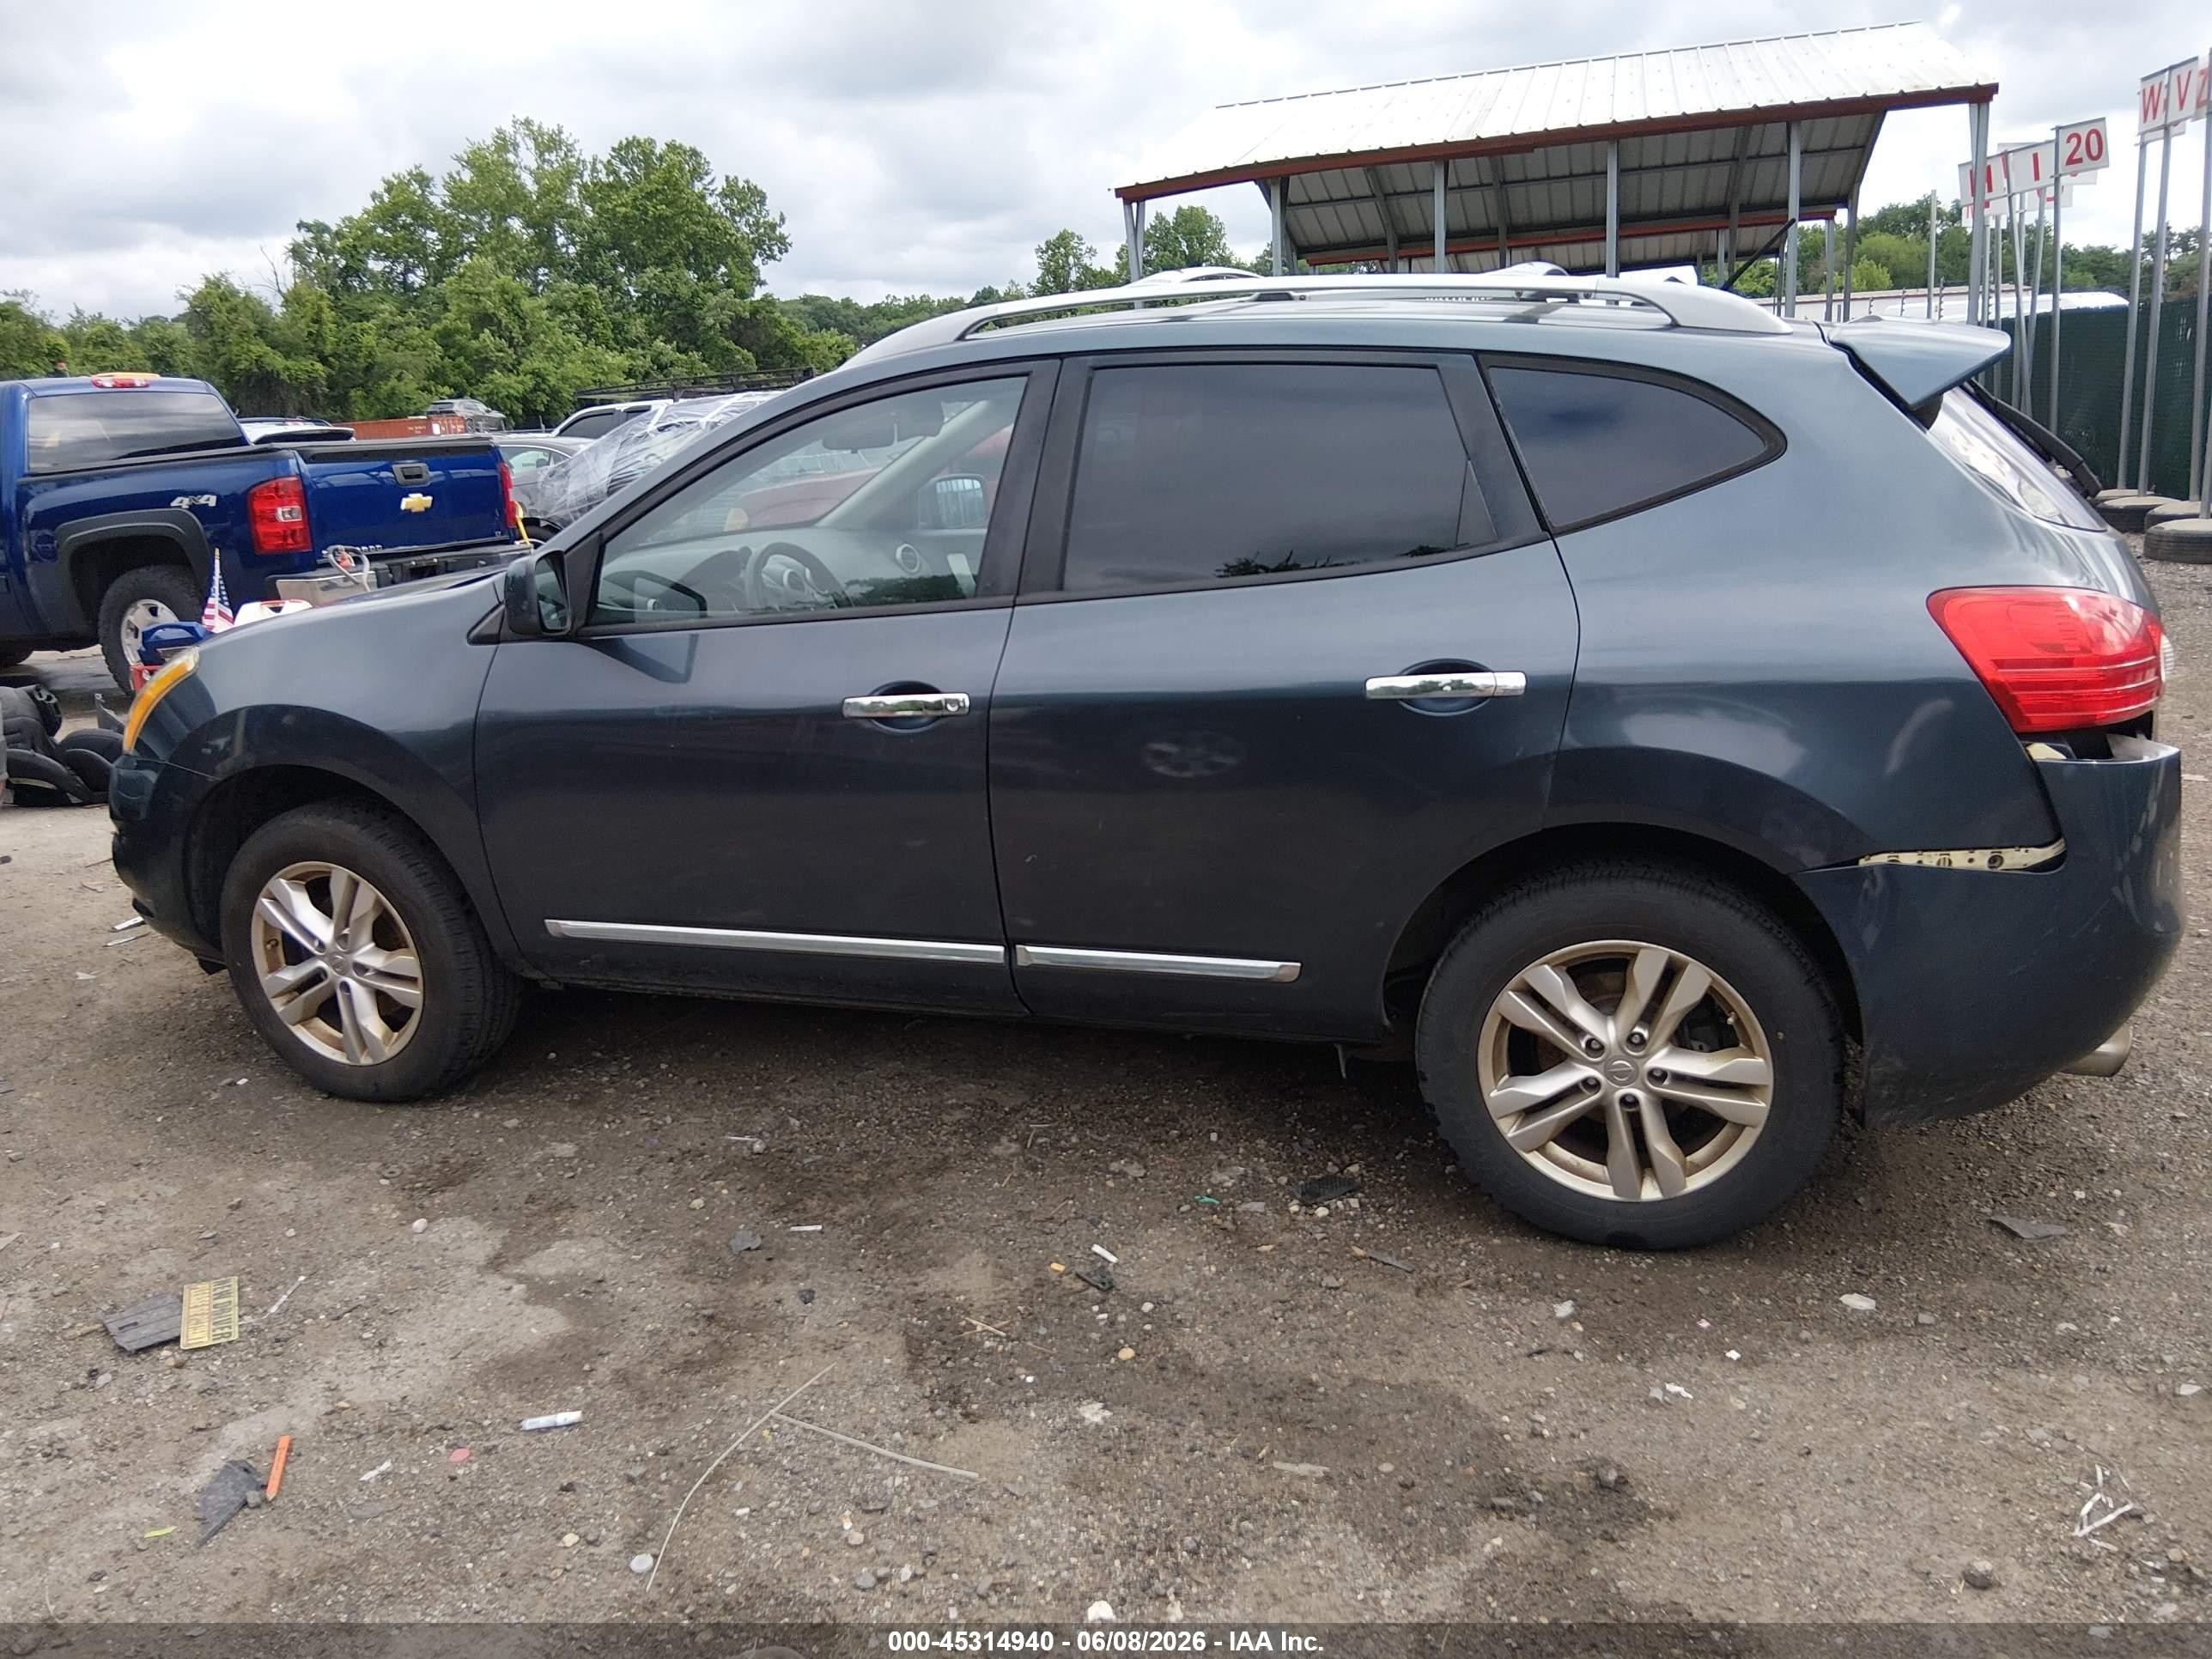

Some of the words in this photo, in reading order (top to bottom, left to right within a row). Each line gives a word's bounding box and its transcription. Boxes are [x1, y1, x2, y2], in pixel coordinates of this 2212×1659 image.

[2142, 81, 2163, 124] W
[2177, 70, 2192, 111] V
[2065, 129, 2104, 166] 20
